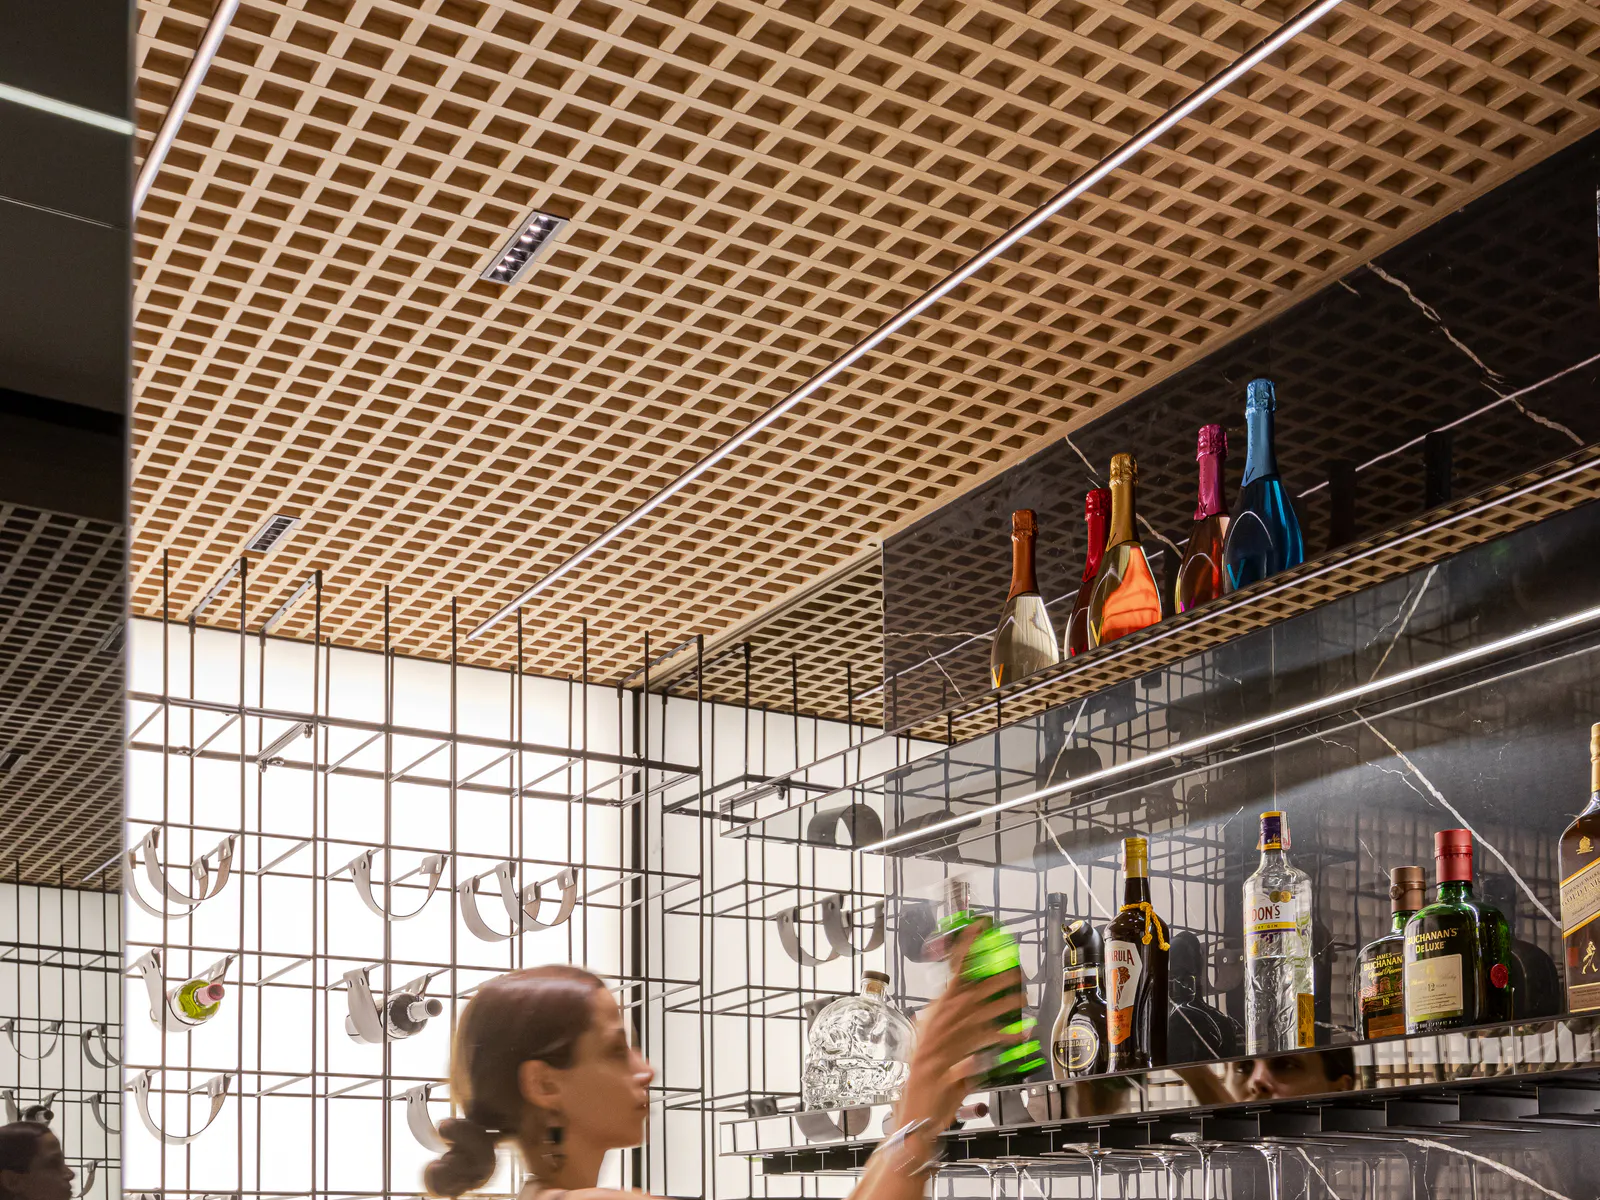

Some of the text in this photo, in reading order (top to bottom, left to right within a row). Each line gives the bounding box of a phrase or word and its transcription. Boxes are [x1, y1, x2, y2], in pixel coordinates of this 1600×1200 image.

[1406, 928, 1459, 945] BUCHANAN'S
[1375, 952, 1393, 961] JAMES
[1382, 996, 1390, 1006] 18
